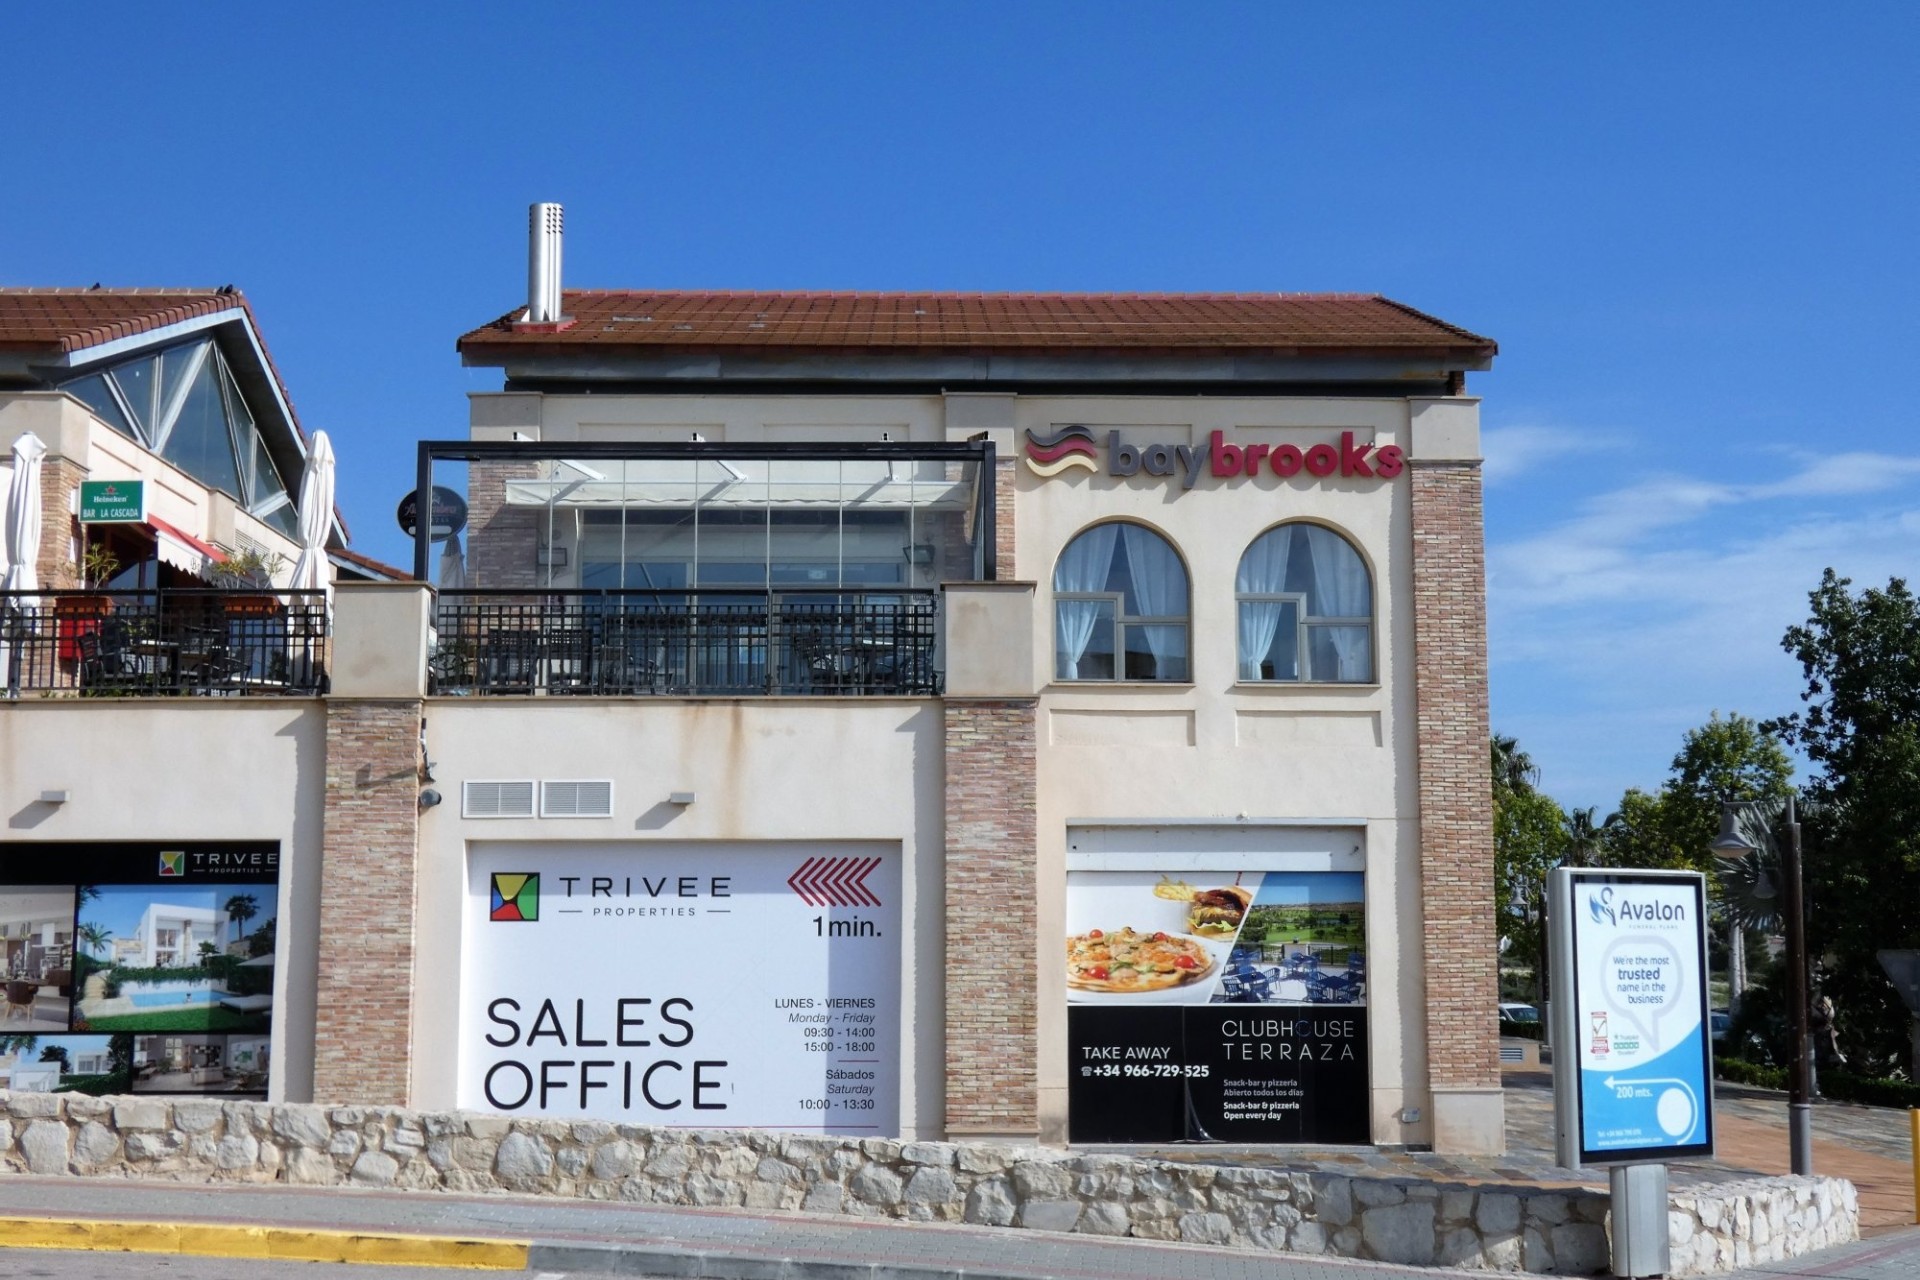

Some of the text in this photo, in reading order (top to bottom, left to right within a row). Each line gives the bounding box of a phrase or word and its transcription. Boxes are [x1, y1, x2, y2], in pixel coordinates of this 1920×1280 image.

[1108, 429, 1403, 489] baybrooks
[83, 508, 138, 518] BAR LA CASCADA
[193, 853, 278, 865] TRIVEE
[559, 877, 731, 898] TRIVEE
[593, 907, 696, 917] PROPERTIES
[1620, 899, 1685, 920] Avalon
[1635, 956, 1648, 965] the
[1650, 957, 1670, 965] most
[1618, 967, 1660, 980] trusted
[1617, 982, 1666, 992] name in the
[775, 998, 813, 1008] LUNES
[825, 998, 875, 1008] VIERNES
[1627, 994, 1664, 1004] business
[485, 998, 694, 1048] SALES
[788, 1012, 832, 1024] Monday
[842, 1012, 875, 1025] Friday
[804, 1027, 834, 1037] 09:30
[846, 1027, 875, 1037] 14:00
[804, 1042, 834, 1052] 15:00
[845, 1042, 875, 1052] 18:00
[1222, 1043, 1354, 1060] TERRAZA
[1082, 1047, 1170, 1059] TAKE AWAY
[826, 1069, 875, 1079] Sábados
[1094, 1064, 1209, 1077] +34 966-729-525
[484, 1060, 728, 1110] OFFICE
[1223, 1079, 1260, 1087] Snack-bar
[827, 1083, 875, 1096] Saturday
[1223, 1089, 1252, 1097] Abierto
[1253, 1089, 1275, 1097] todos
[1276, 1089, 1287, 1097] los
[1616, 1086, 1634, 1098] 200
[800, 1099, 830, 1110] 10:00
[843, 1099, 875, 1110] 13:30
[1223, 1102, 1260, 1110] Snack-bar
[1262, 1102, 1268, 1110] &
[1223, 1111, 1282, 1121] Open every day
